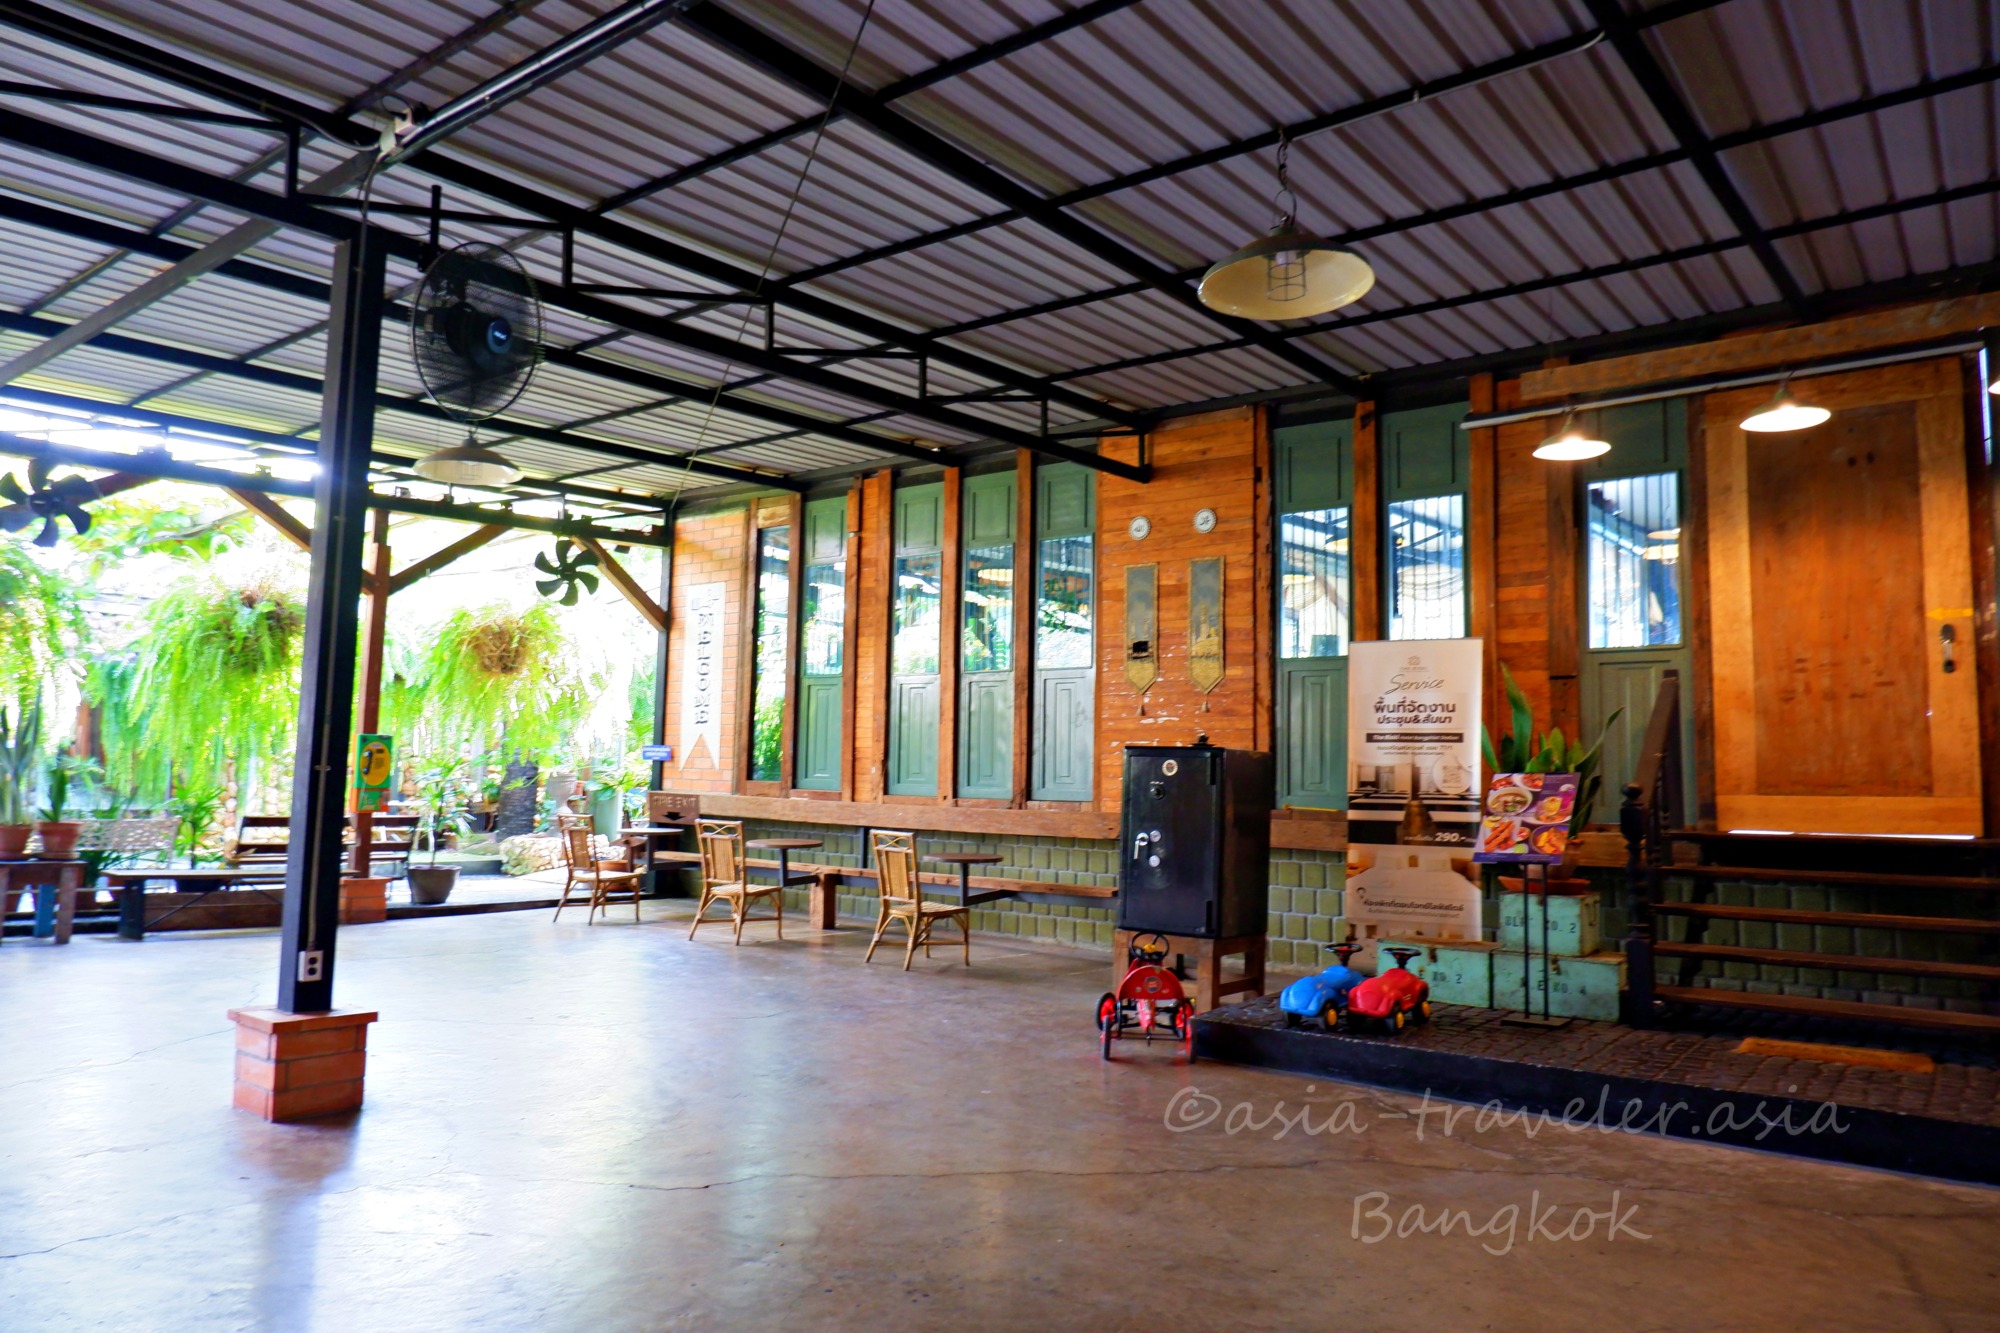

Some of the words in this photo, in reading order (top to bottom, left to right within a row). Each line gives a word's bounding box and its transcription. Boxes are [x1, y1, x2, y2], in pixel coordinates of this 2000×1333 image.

[694, 613, 714, 725] WELCOME
[1385, 673, 1445, 695] Service
[1374, 697, 1457, 714] พื้นที่จัดงาน
[675, 796, 697, 808] EXIT
[1569, 923, 1577, 933] 2
[1456, 973, 1463, 984] 2
